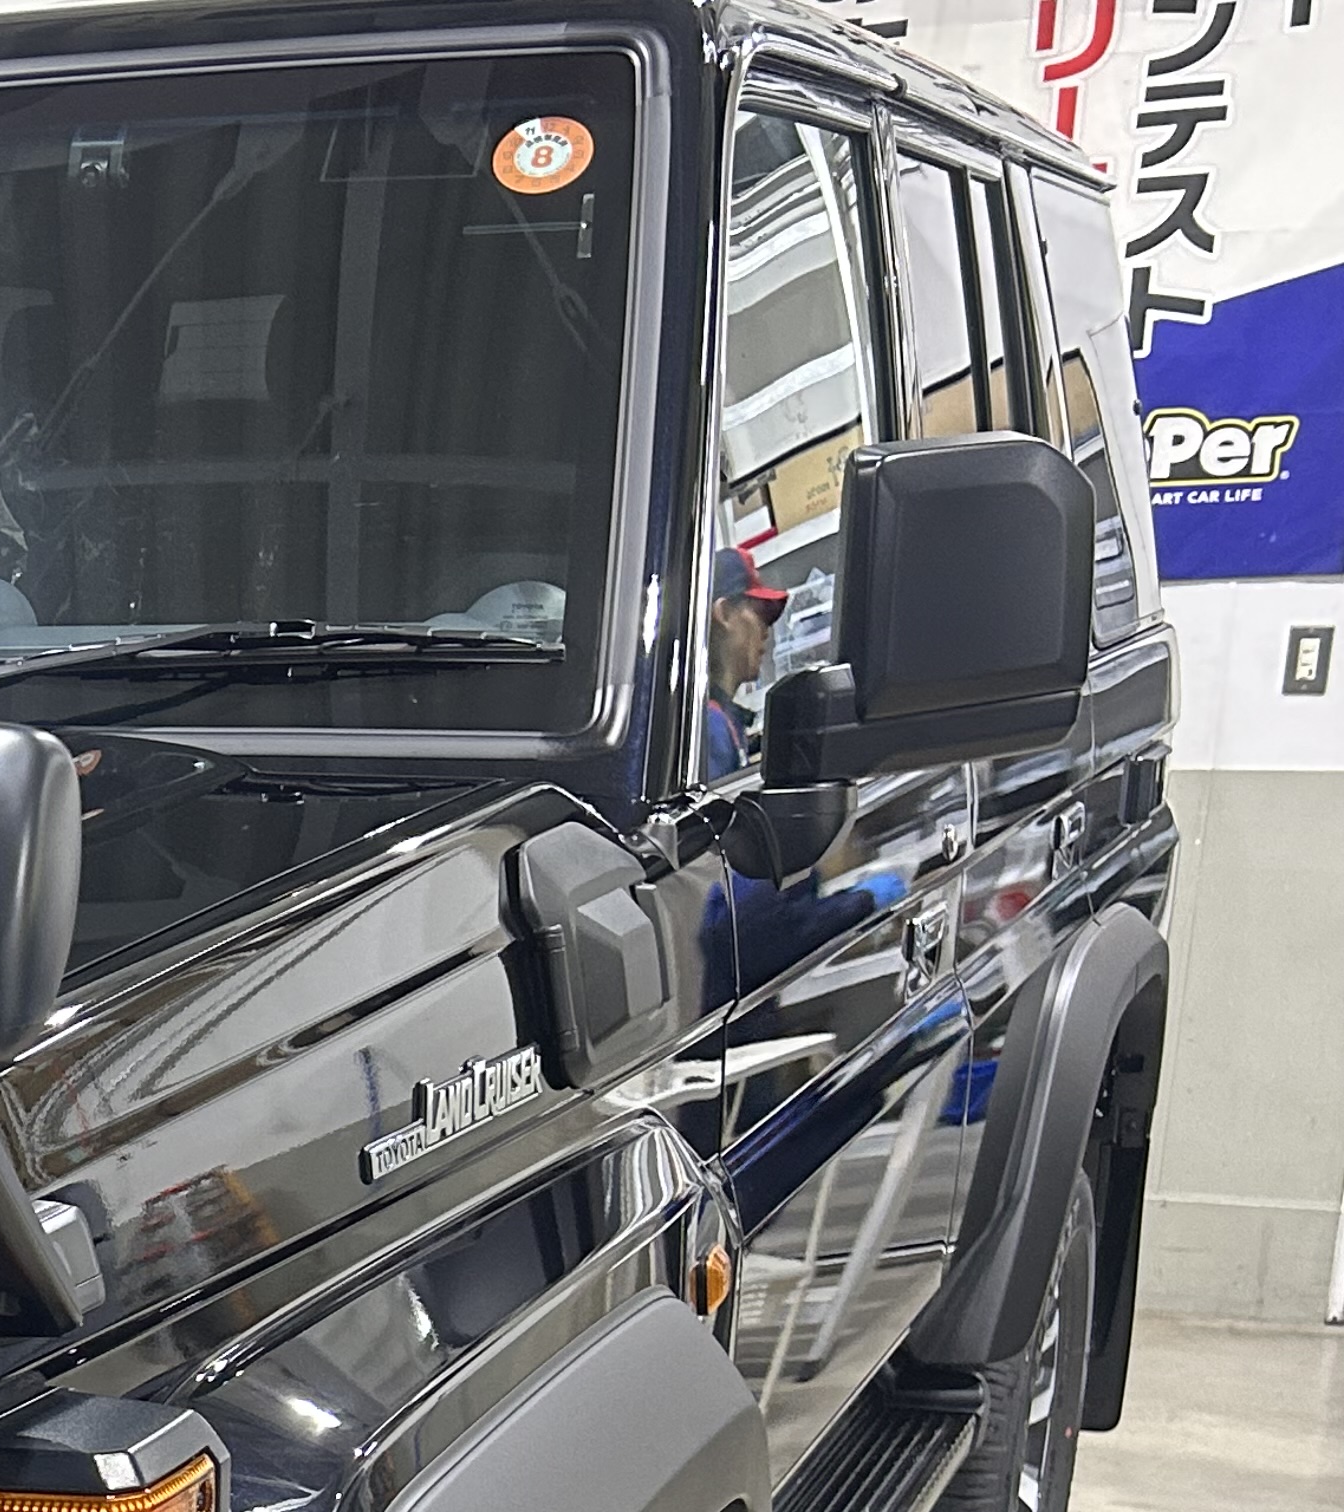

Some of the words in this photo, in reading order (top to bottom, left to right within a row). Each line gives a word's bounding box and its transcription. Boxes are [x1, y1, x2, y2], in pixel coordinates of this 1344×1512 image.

[531, 145, 554, 169] 8
[1145, 410, 1297, 482] Per
[1186, 490, 1220, 504] CAR
[1224, 488, 1263, 502] LIFE
